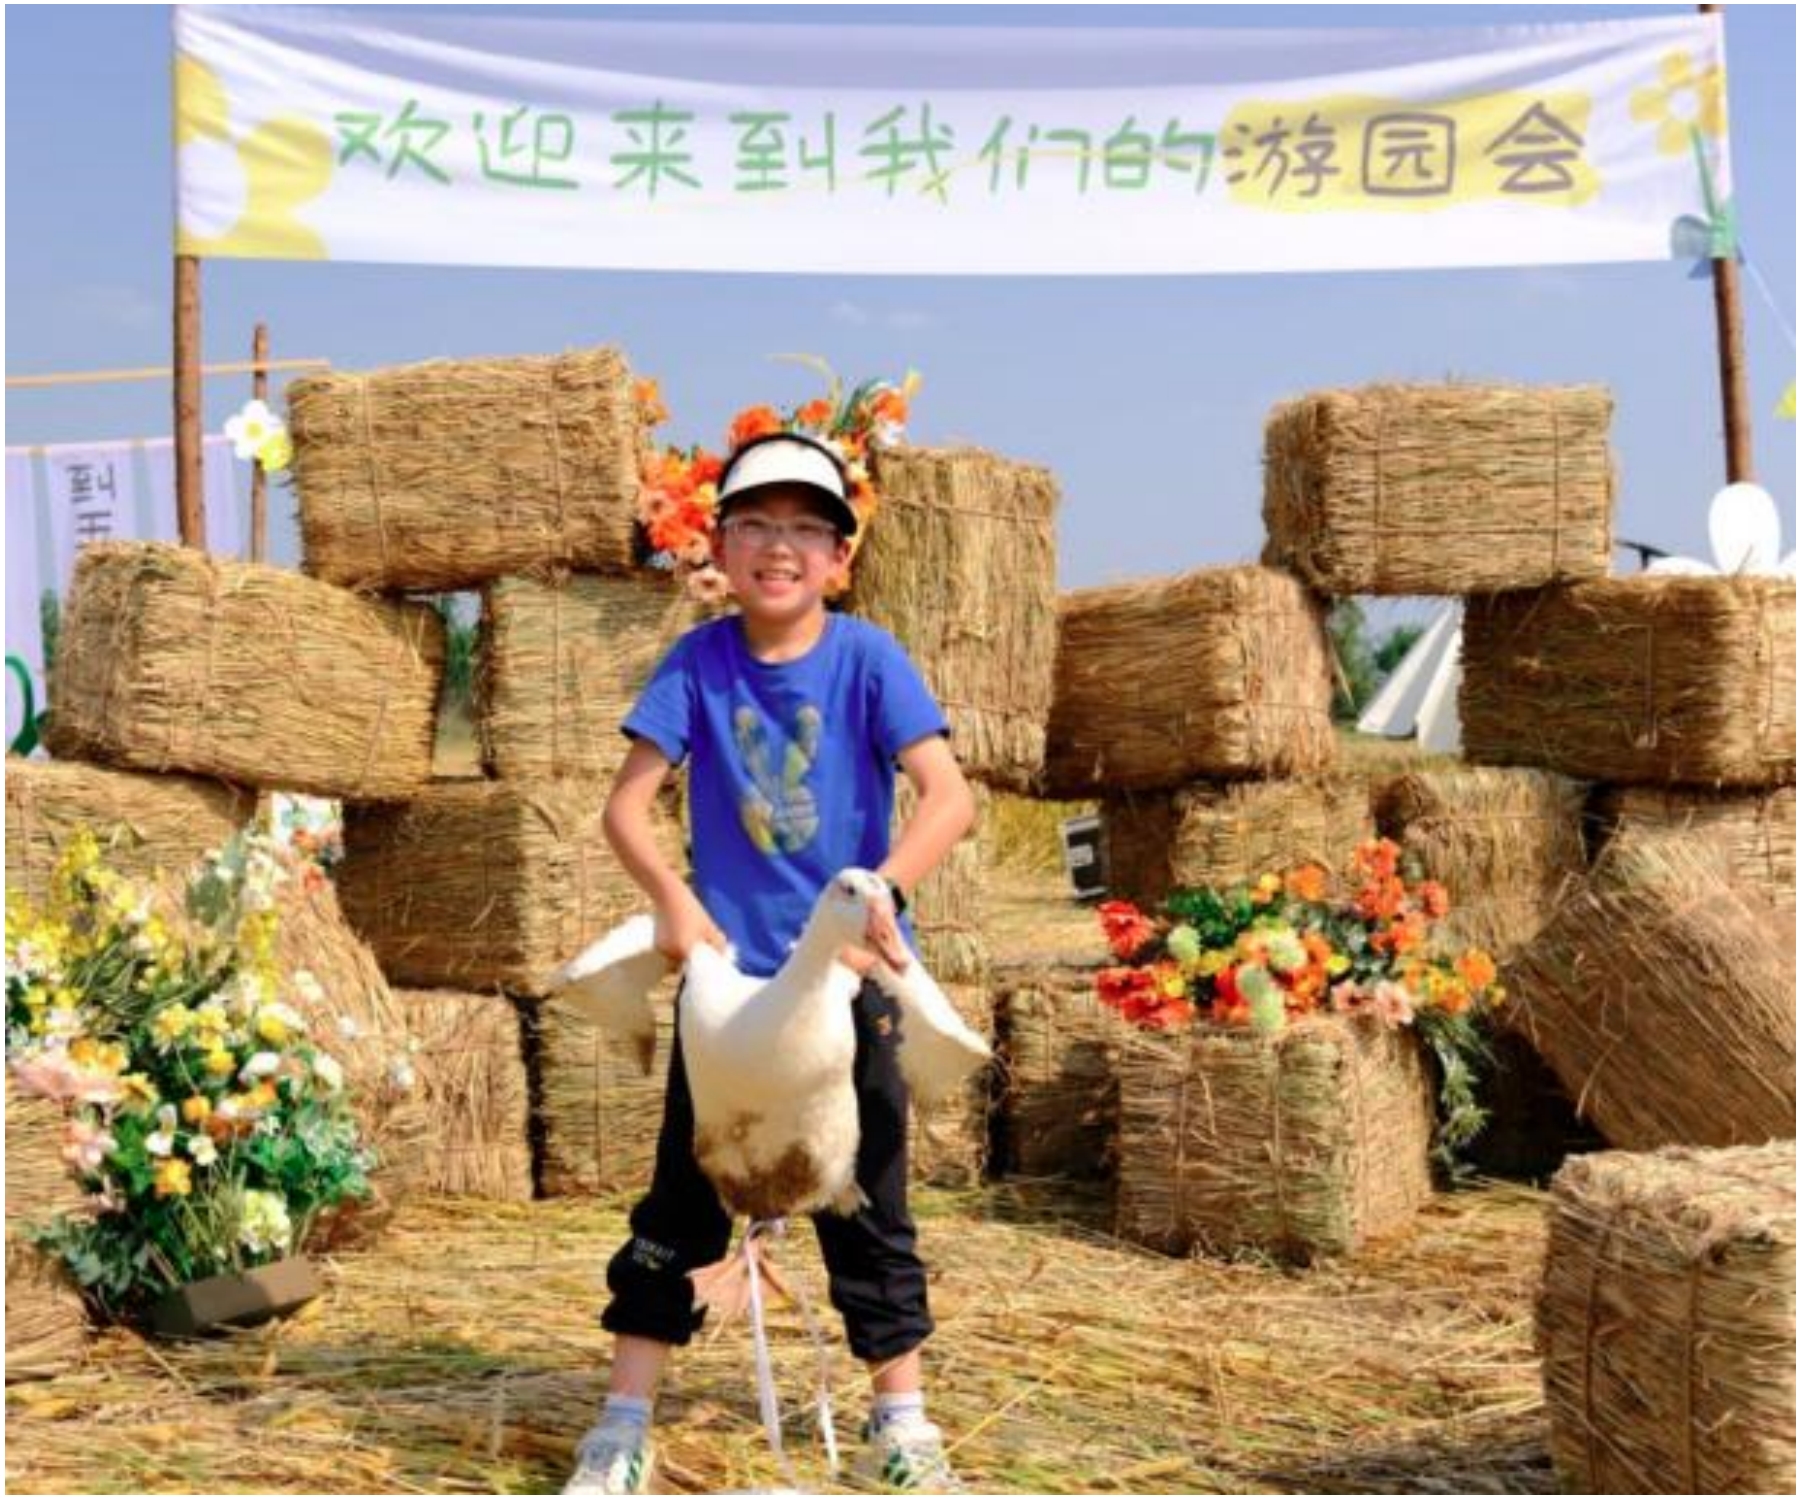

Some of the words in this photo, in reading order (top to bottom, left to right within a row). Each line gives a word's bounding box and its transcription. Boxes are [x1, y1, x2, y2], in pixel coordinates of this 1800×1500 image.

[335, 98, 1585, 206] 欢迎来到我们的游园会
